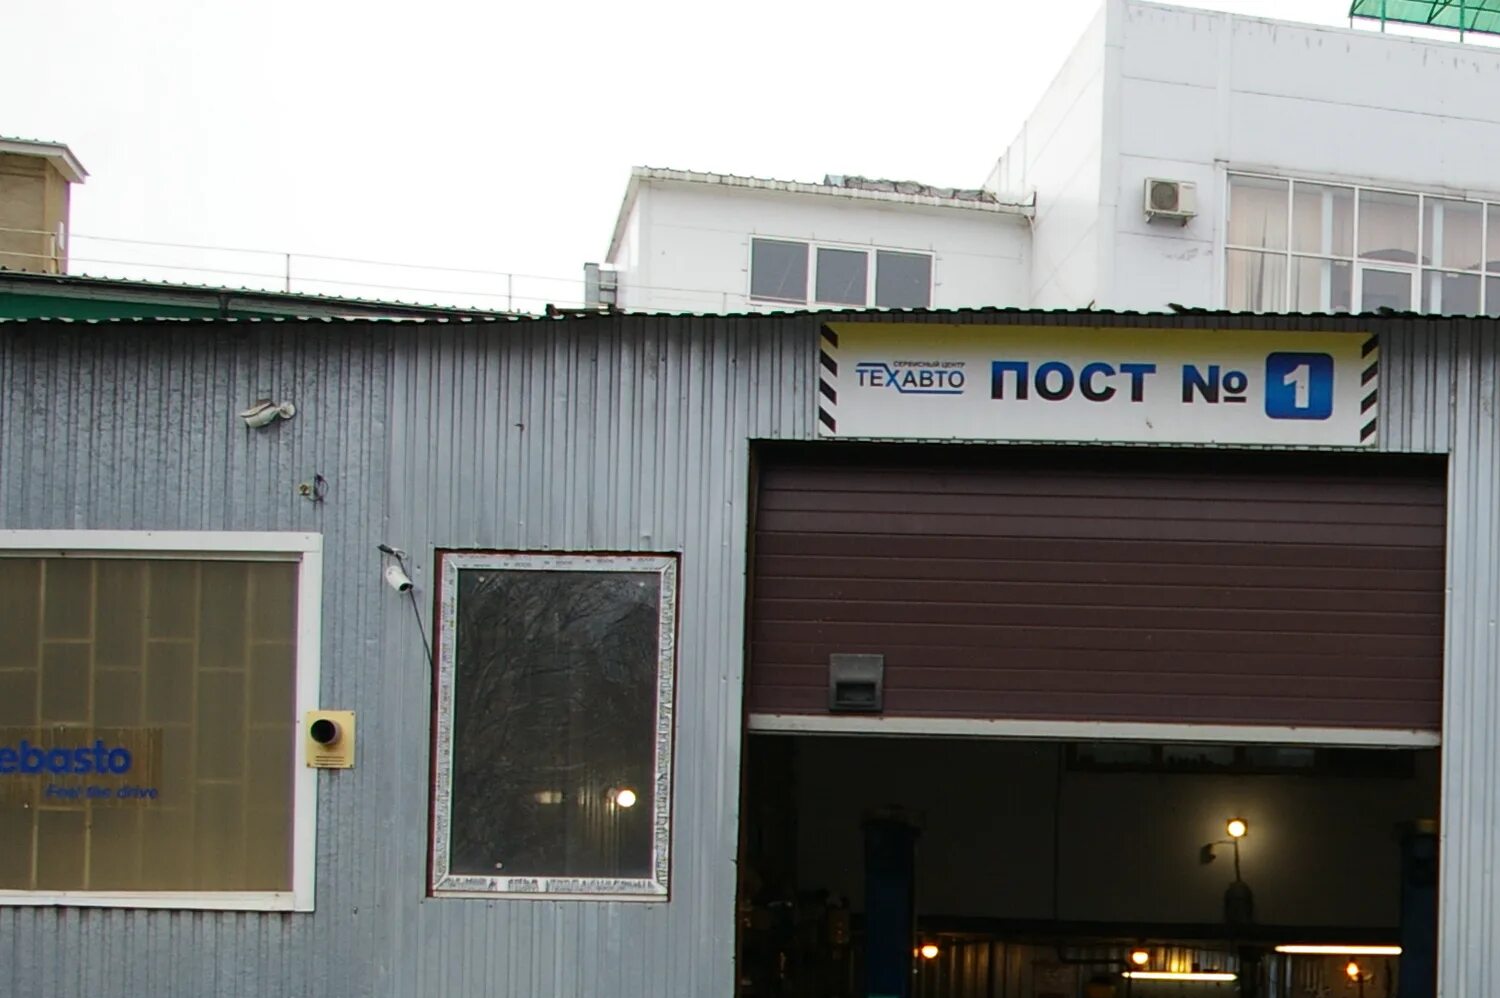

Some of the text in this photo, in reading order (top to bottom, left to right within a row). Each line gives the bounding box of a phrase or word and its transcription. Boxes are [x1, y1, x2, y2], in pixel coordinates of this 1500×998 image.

[855, 369, 965, 388] ТЕХАВТО
[991, 360, 1156, 402] ПОСТ
[1282, 363, 1309, 409] 1
